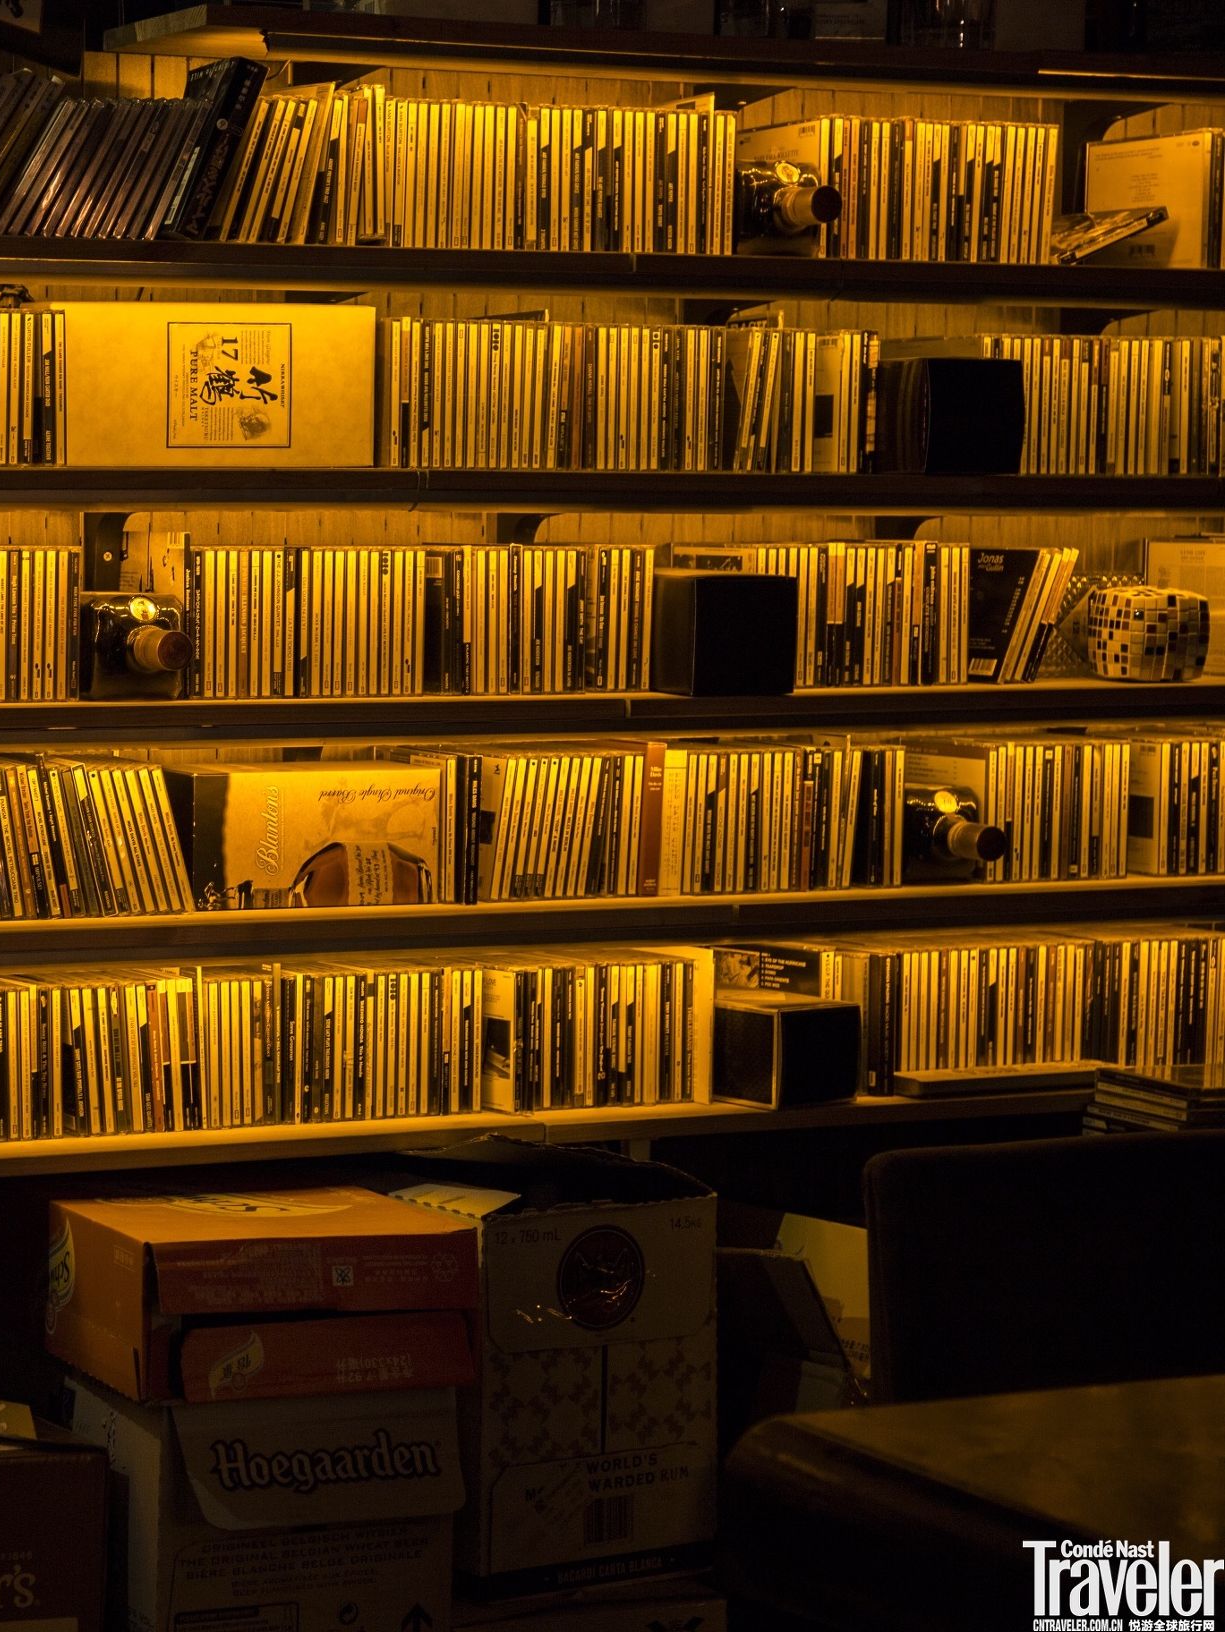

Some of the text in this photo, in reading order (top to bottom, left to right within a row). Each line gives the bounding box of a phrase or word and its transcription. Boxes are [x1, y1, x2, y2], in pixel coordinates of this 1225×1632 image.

[221, 337, 238, 361] 17
[189, 350, 198, 421] PURE MALT
[200, 366, 278, 405] 竹鶴
[978, 553, 1004, 564] Jonas
[494, 1231, 507, 1245] 12
[520, 1230, 539, 1243] 750
[211, 1431, 438, 1495] Hoegaarden
[587, 1453, 659, 1474] WORLD'S
[587, 1466, 689, 1493] WARDED RUM
[180, 1557, 207, 1568] THE
[211, 1551, 276, 1565] ORIGINAL
